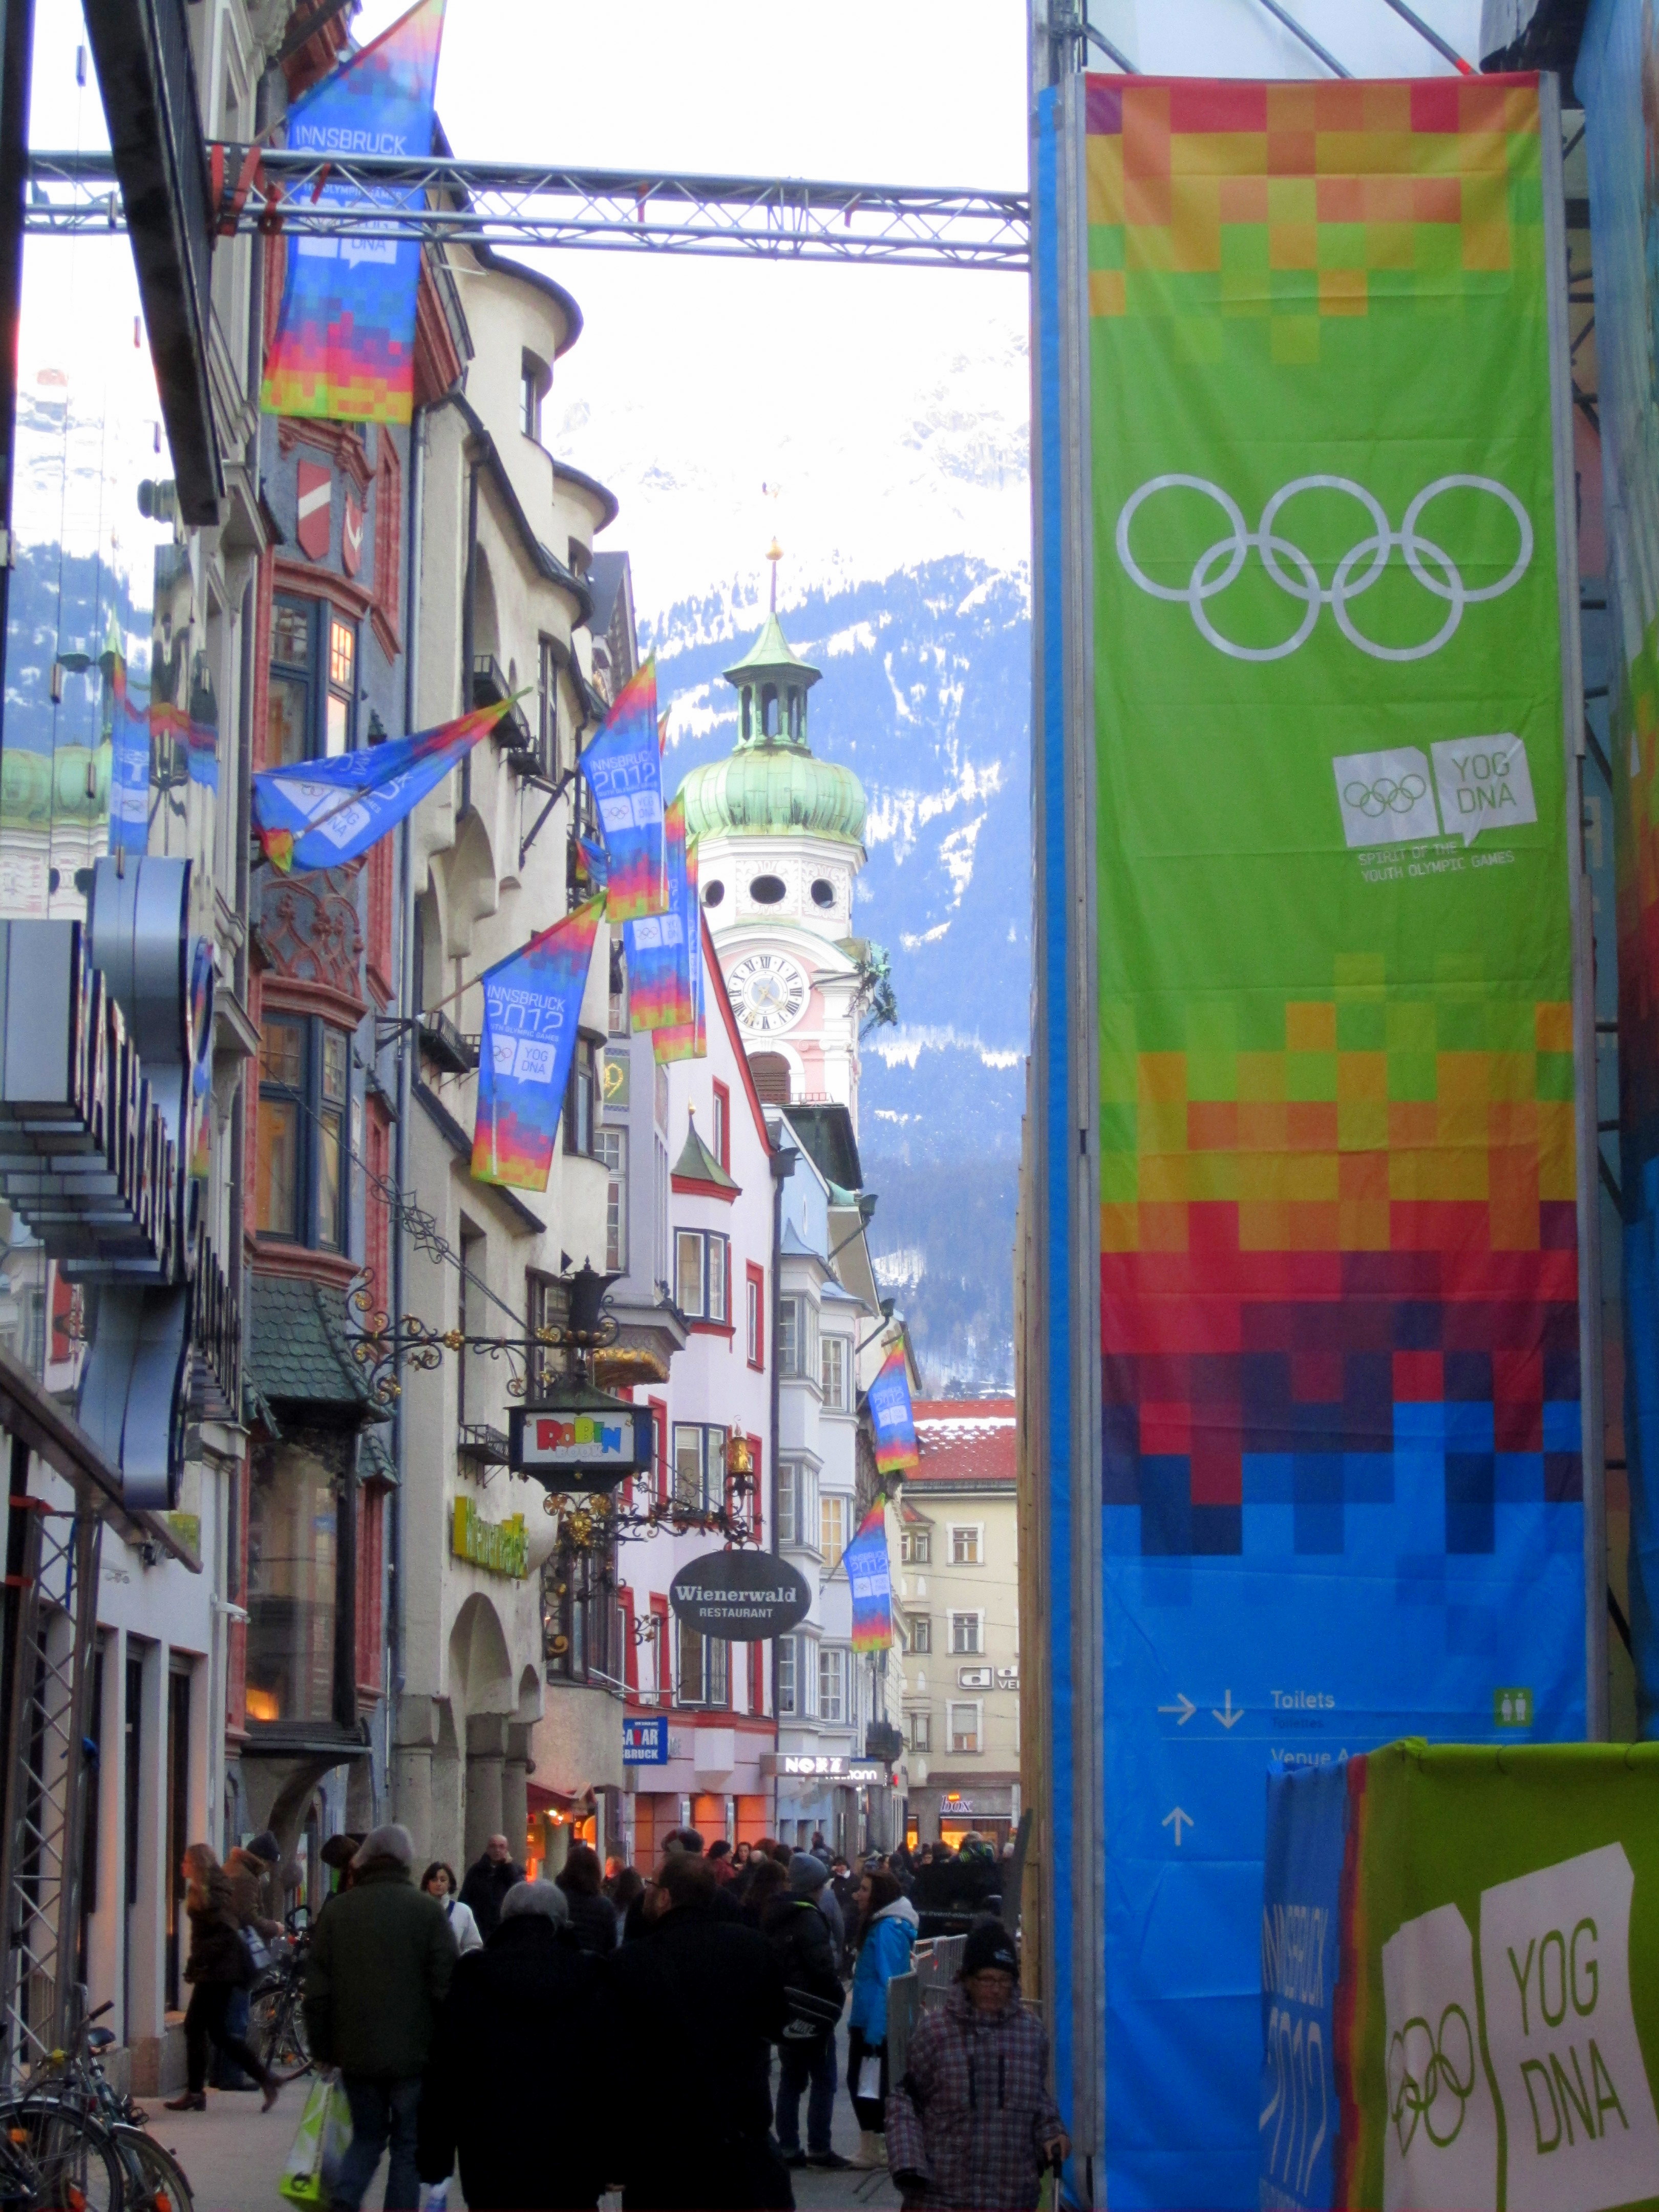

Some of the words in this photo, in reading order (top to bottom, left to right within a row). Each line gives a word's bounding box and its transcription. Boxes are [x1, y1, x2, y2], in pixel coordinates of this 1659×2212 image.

[296, 126, 407, 155] INNSBRUCK
[593, 762, 656, 792] 2012
[1452, 751, 1511, 782] YOG
[1456, 783, 1517, 814] DNA
[1358, 849, 1406, 866] SPIRIT
[1412, 845, 1427, 859] OF
[1433, 841, 1457, 855] THE
[1361, 866, 1403, 882] YOUTH
[1408, 857, 1464, 877] OLYMPIC
[1471, 850, 1515, 868] GAMES
[487, 985, 566, 1012] INNSBRUCK
[488, 999, 563, 1032] 2012
[505, 1026, 534, 1037] OLYMPIC
[536, 1031, 560, 1042] GAMES
[521, 1060, 545, 1074] DNA
[525, 1047, 548, 1061] YOG
[536, 1417, 622, 1454] ROBIN
[675, 1586, 797, 1602] Wienerwald
[699, 1607, 773, 1618] RESTAURANT
[1270, 1690, 1335, 1709] Toilets
[623, 1749, 659, 1759] BRUCK
[1270, 1748, 1331, 1765] Venue
[940, 1795, 973, 1812] box
[1506, 1916, 1600, 2037] YOG
[1521, 2038, 1630, 2155] DNA
